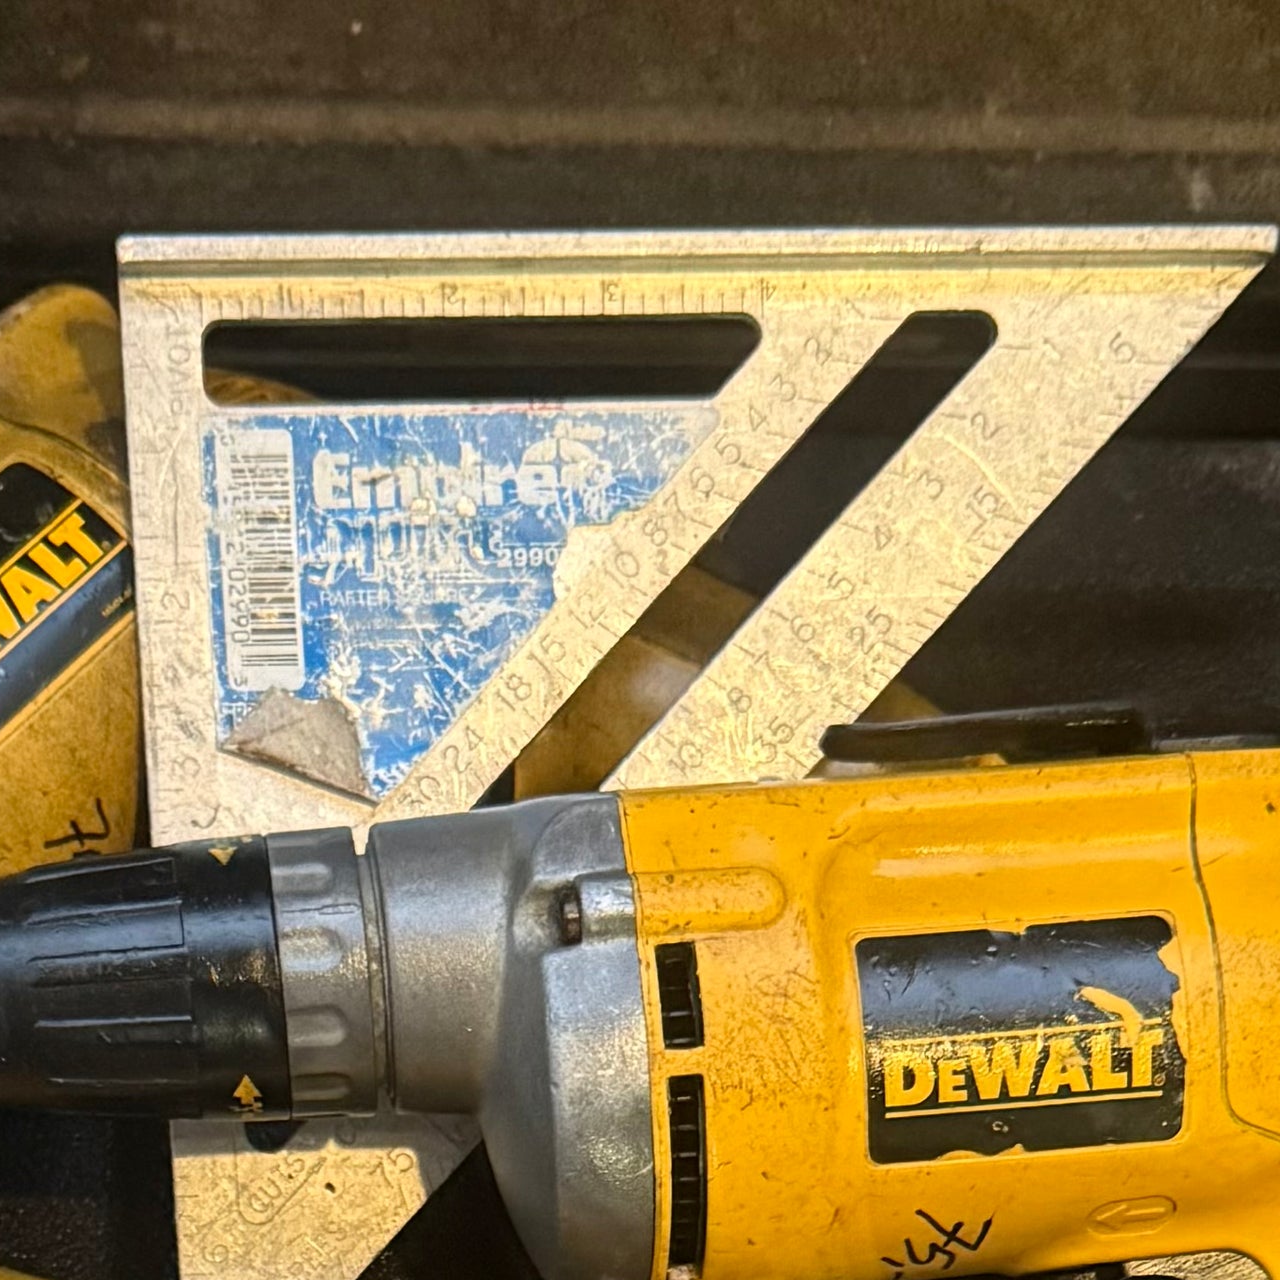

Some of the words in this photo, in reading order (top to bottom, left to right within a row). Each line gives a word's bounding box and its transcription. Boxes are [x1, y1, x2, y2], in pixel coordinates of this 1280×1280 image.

[1108, 331, 1137, 364] 5
[714, 436, 742, 466] 5
[689, 466, 716, 496] 6
[662, 491, 686, 521] 7
[642, 517, 669, 547] 8
[498, 547, 558, 569] 2990
[604, 549, 640, 591] 10
[826, 570, 856, 600] 5
[570, 593, 608, 629] 12
[790, 614, 817, 643] 6
[844, 604, 894, 656] 25
[527, 633, 567, 676] 15
[497, 673, 534, 716] 18
[726, 686, 753, 714] 8
[751, 715, 796, 764] 35
[883, 1028, 1164, 1108] DEWALT
[368, 1149, 415, 1189] 75
